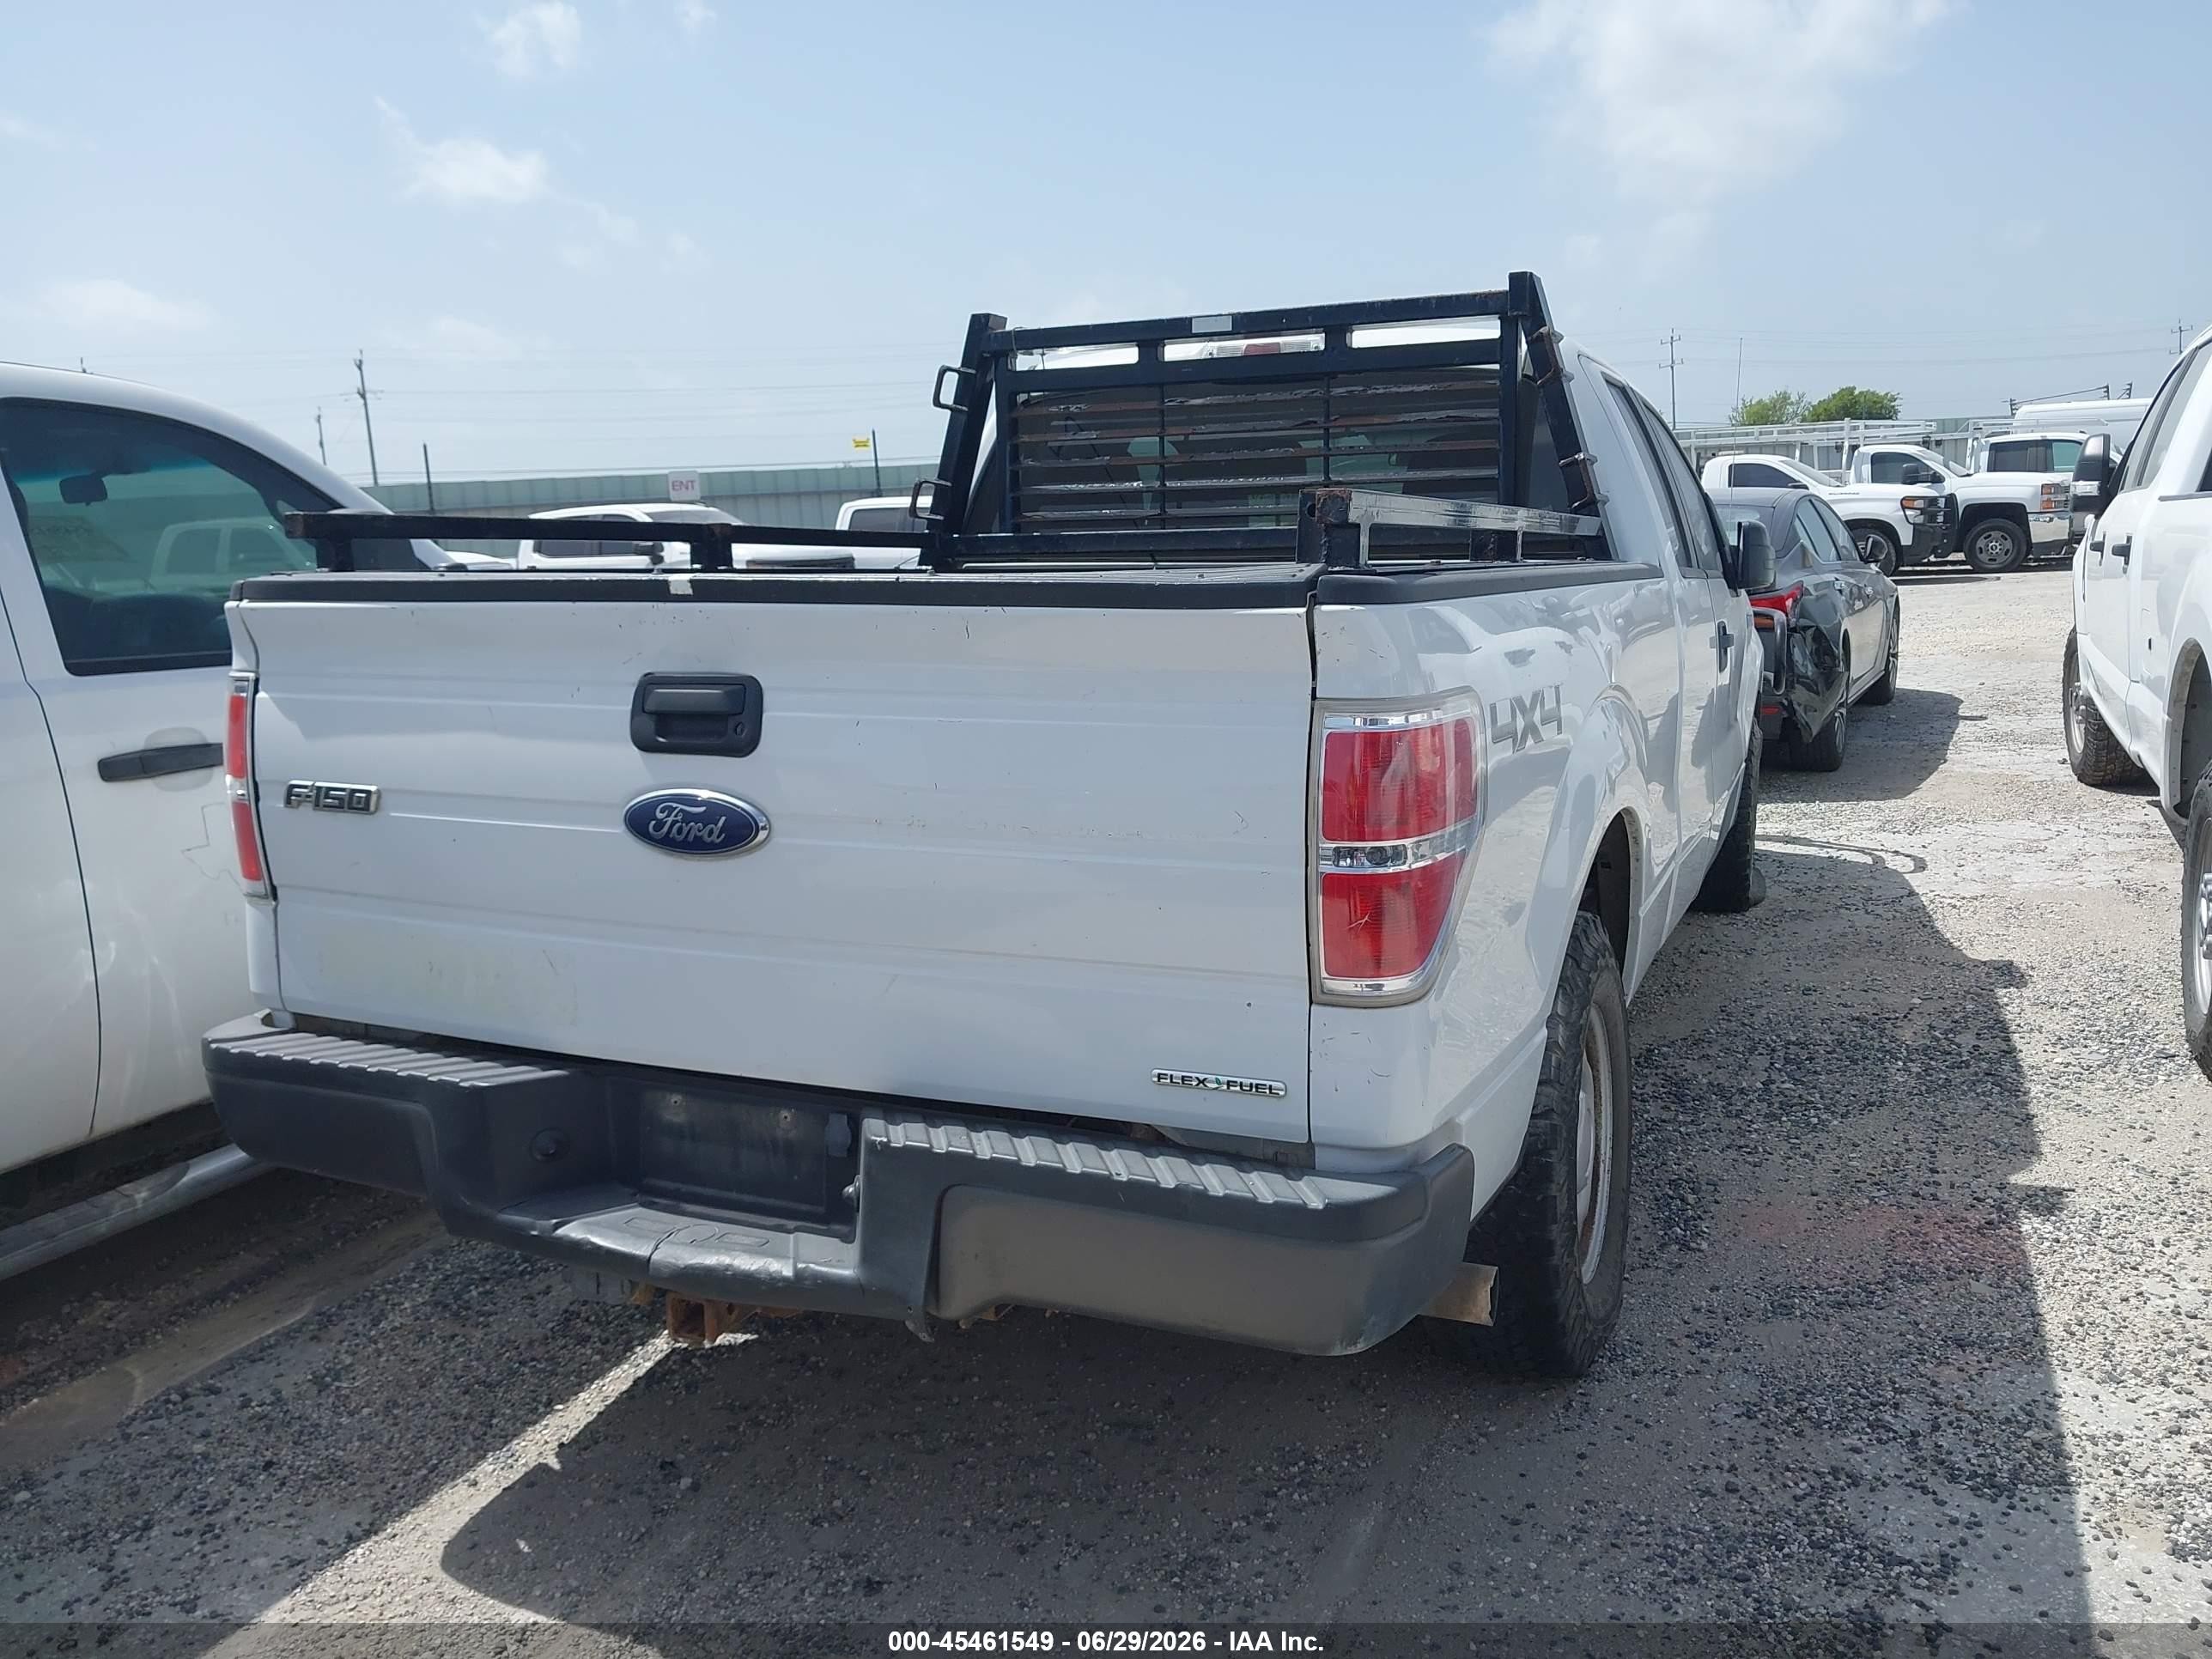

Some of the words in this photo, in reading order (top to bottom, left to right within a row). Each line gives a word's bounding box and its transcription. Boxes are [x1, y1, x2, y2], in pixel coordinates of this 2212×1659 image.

[671, 479, 695, 491] ENT
[1489, 684, 1563, 754] 4X4
[648, 801, 727, 844] Ford
[1156, 1073, 1208, 1088] FLEX
[1225, 1079, 1280, 1096] FUEL
